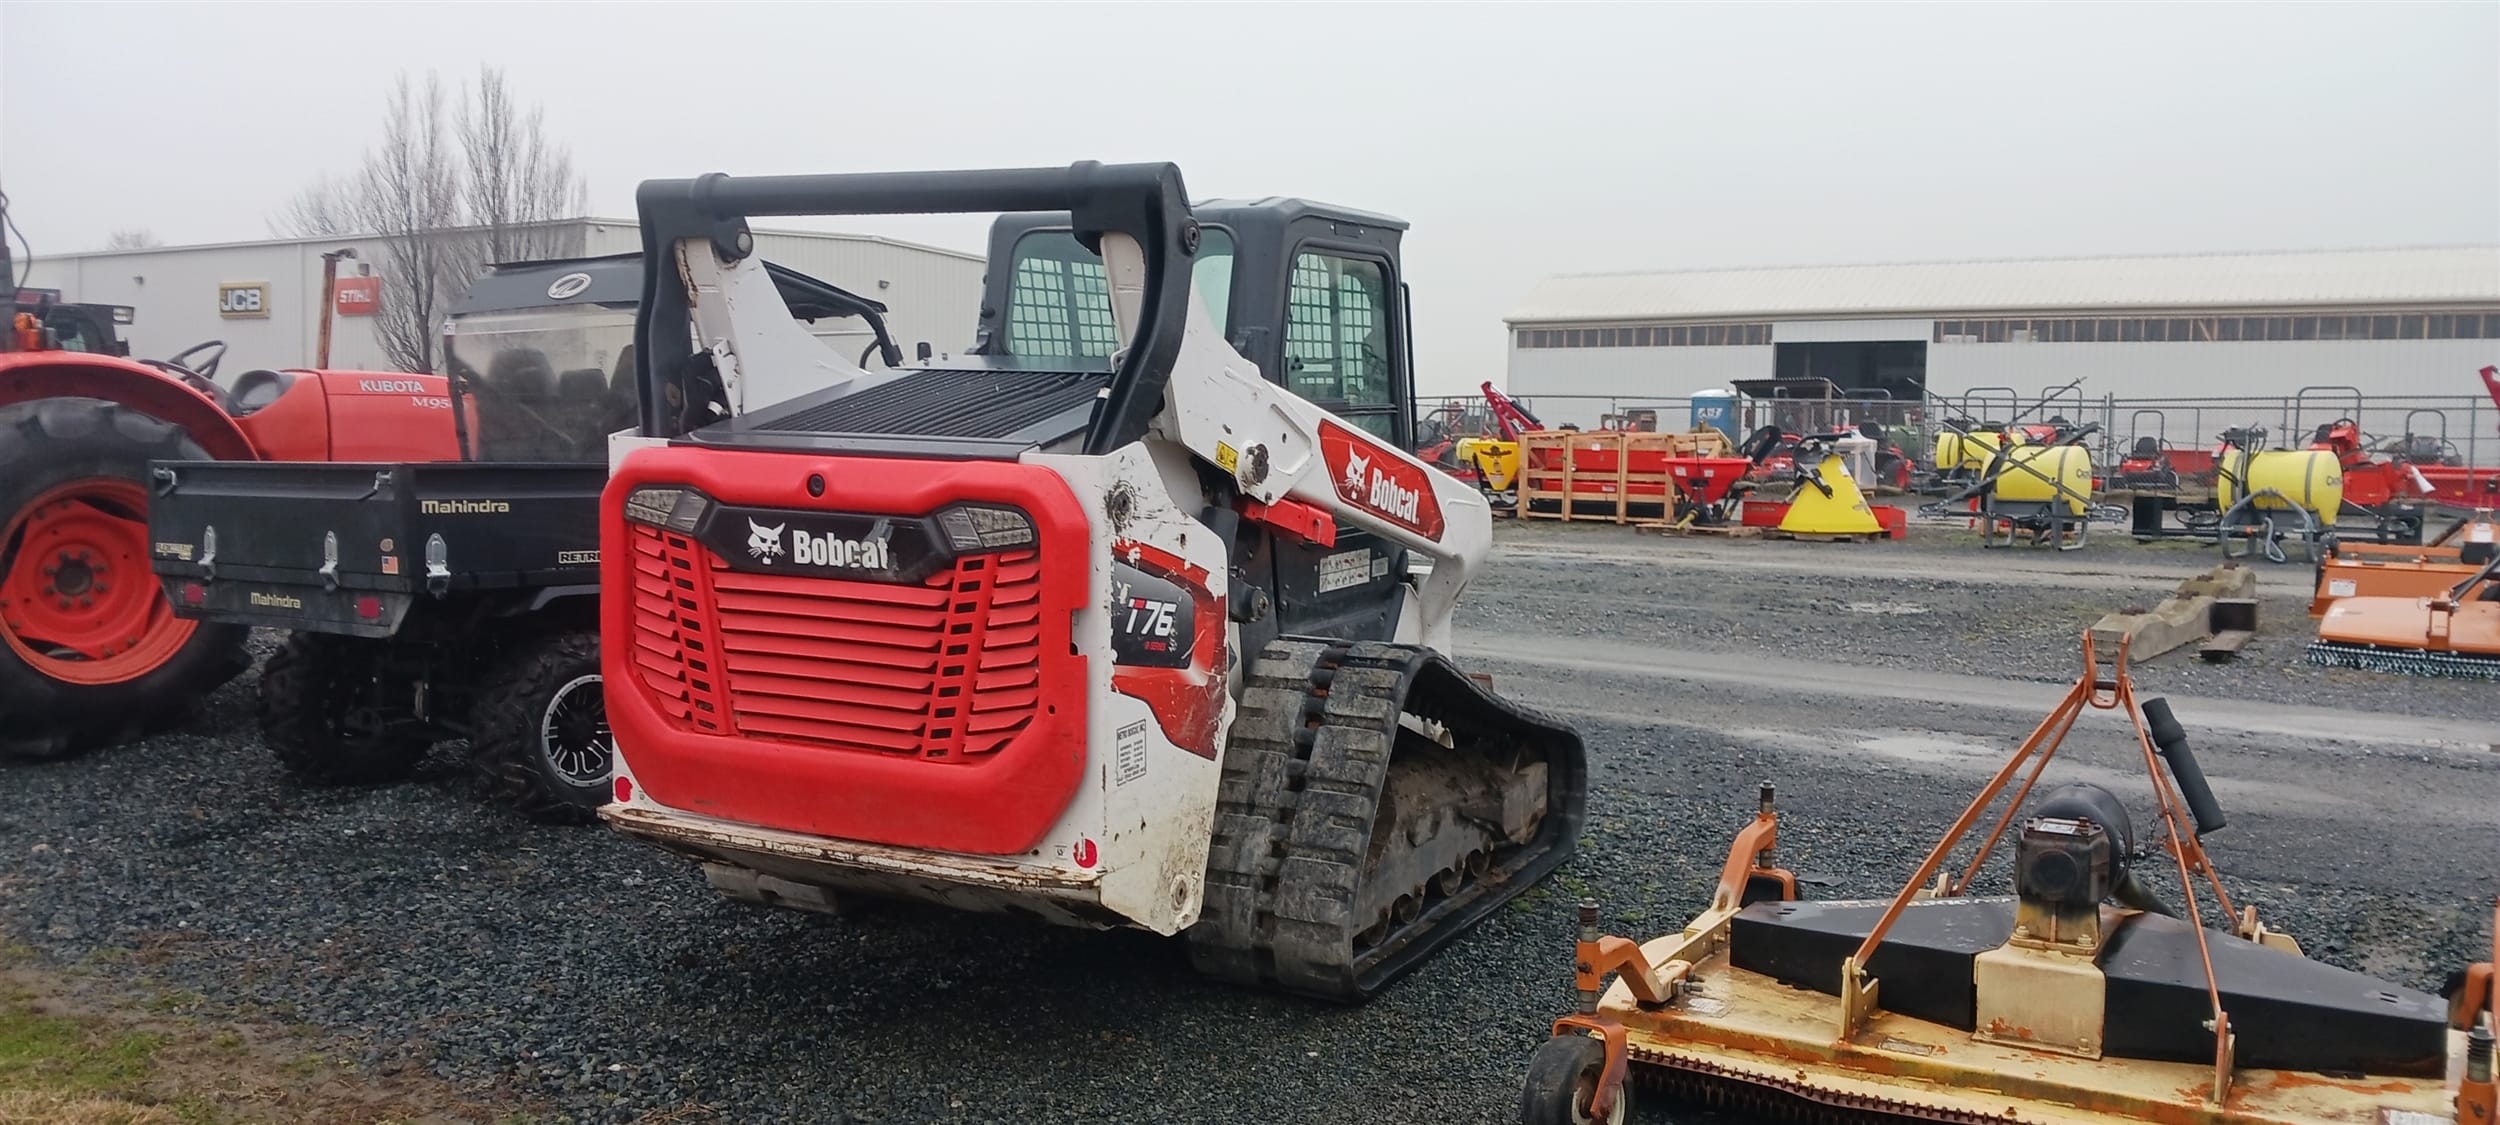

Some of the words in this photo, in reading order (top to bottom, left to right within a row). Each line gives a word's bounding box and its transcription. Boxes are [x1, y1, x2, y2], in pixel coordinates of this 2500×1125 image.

[220, 288, 261, 311] JCB
[339, 289, 371, 303] STIHL
[360, 379, 424, 392] KUBOTA
[1370, 467, 1418, 524] Bobcat
[421, 500, 510, 514] Mahindra
[793, 530, 888, 569] Bobcat
[250, 592, 301, 609] Mahindra
[1126, 598, 1177, 636] T76
